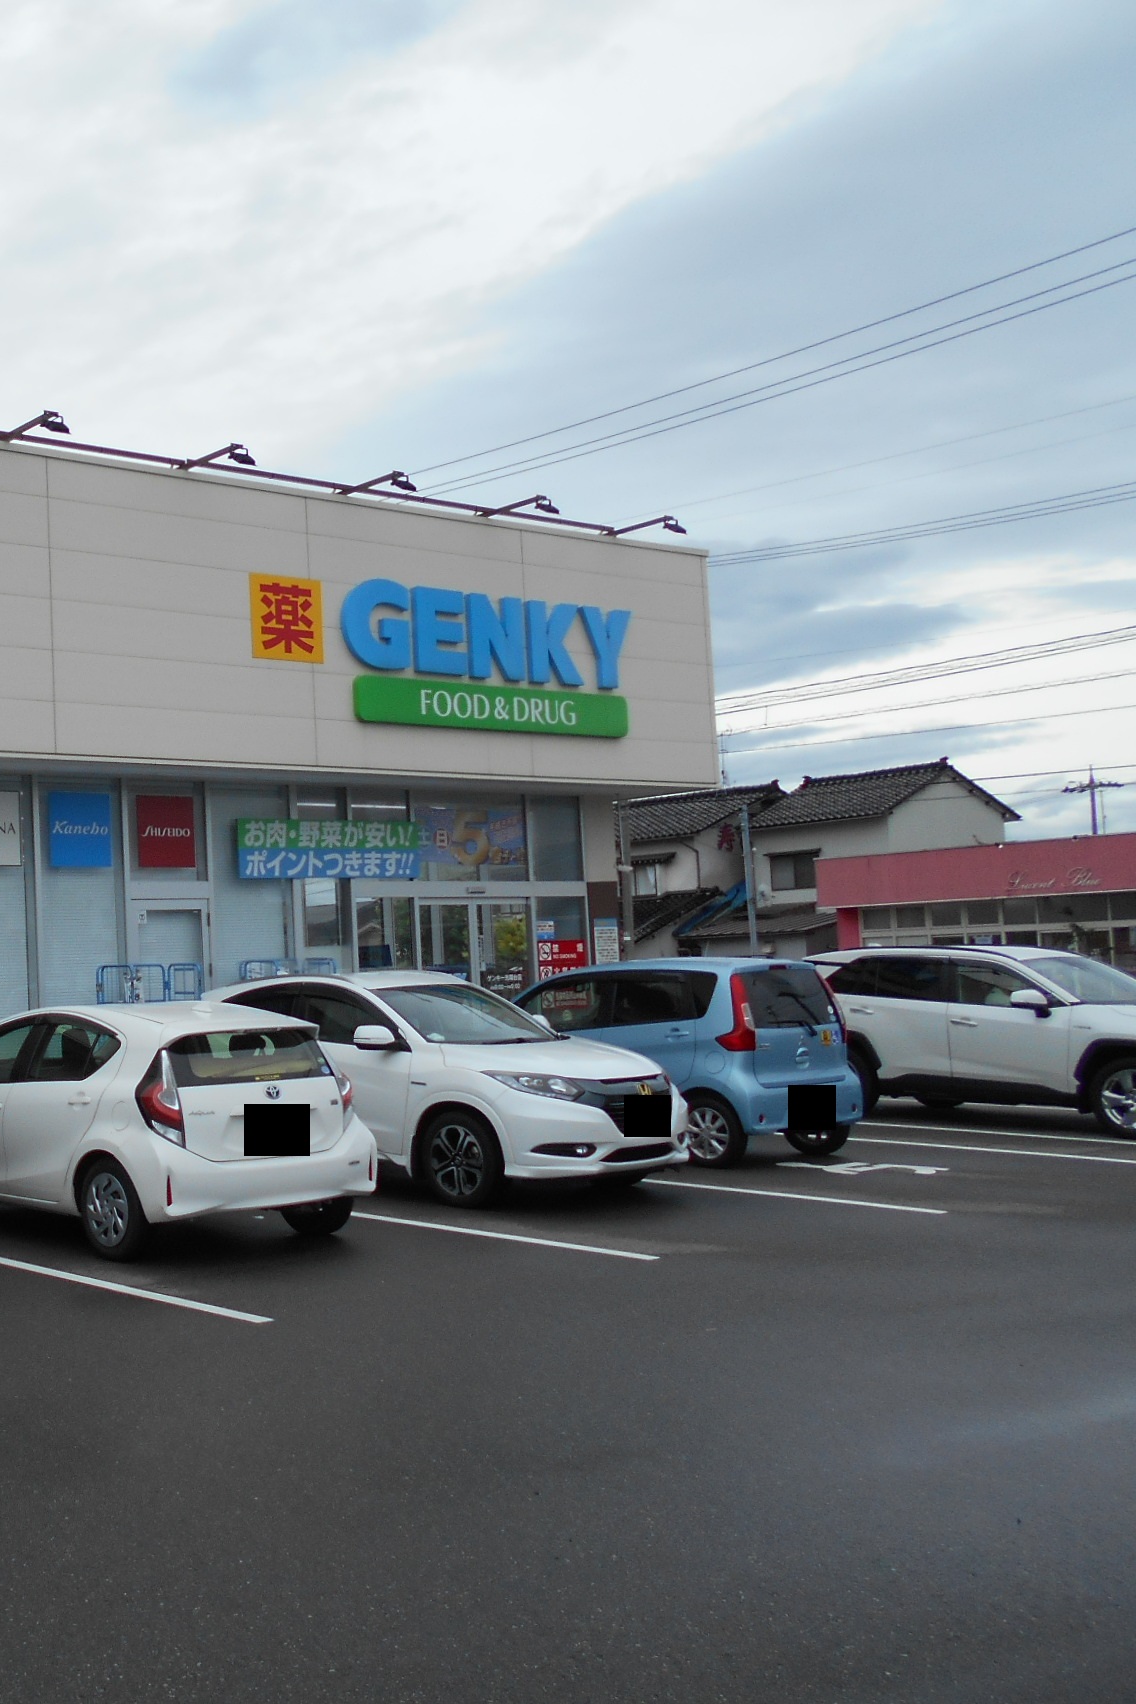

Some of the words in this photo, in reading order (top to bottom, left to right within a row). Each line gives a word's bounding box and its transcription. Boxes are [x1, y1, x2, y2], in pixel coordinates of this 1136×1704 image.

[259, 582, 315, 654] 薬
[340, 578, 632, 690] GENKY
[52, 820, 109, 835] Kanebo
[141, 824, 191, 838] SHISEIDO
